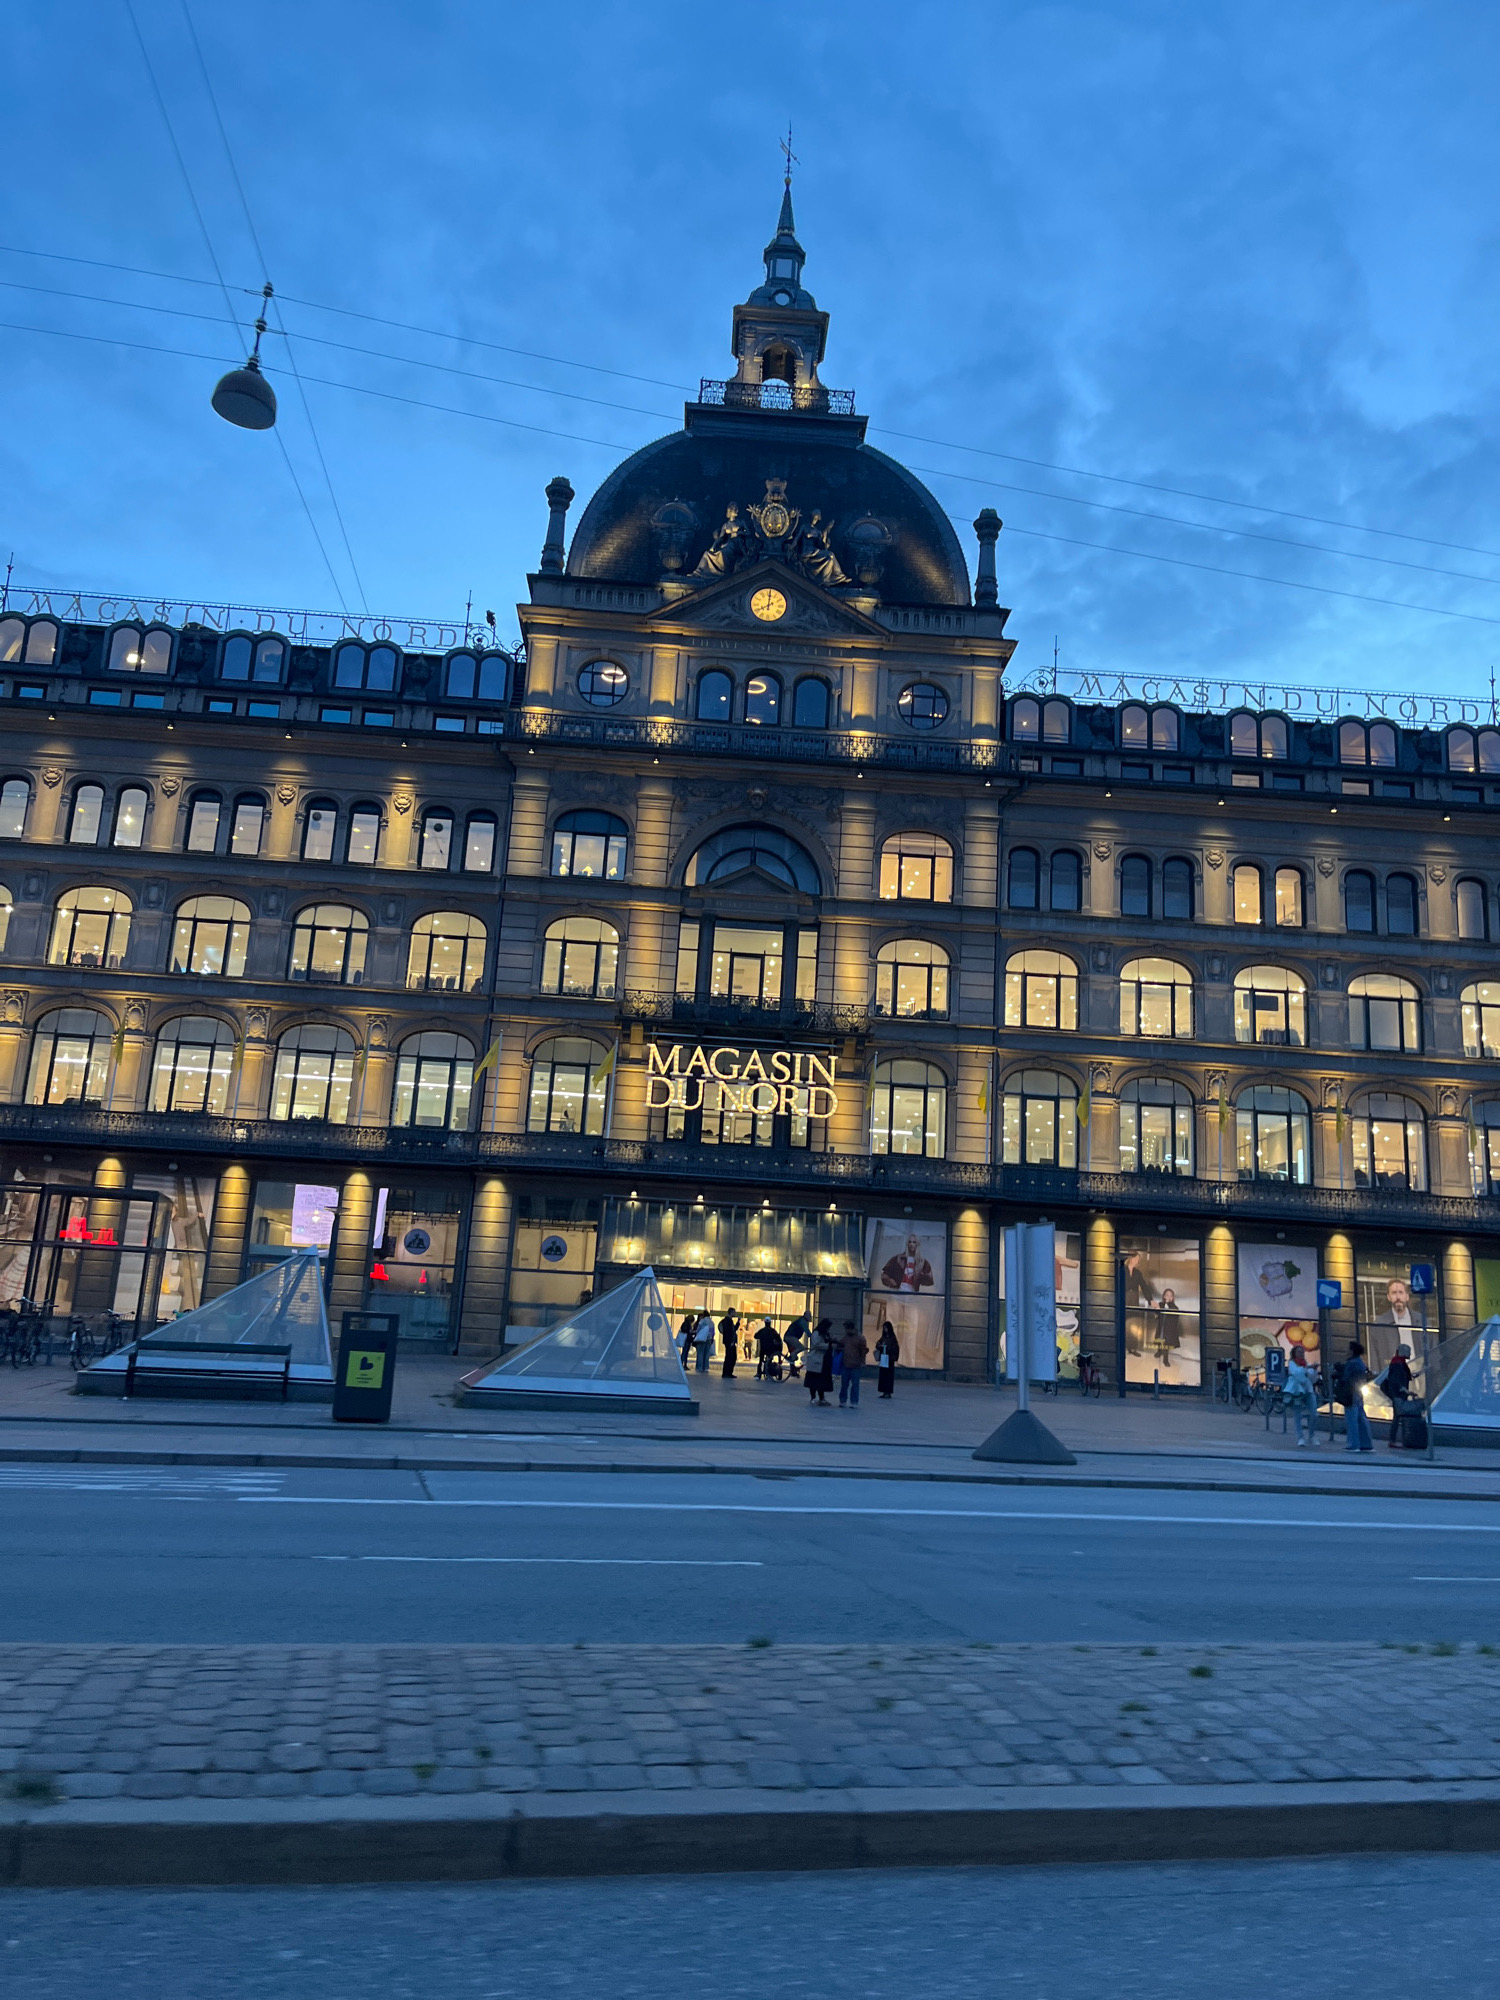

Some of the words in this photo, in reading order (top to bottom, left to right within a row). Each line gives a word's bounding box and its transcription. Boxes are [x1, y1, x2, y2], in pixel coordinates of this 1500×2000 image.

[23, 593, 226, 629] MAGASIN
[253, 611, 306, 637] DU
[338, 618, 457, 648] NORD
[1073, 674, 1265, 708] MAGASIN
[1281, 689, 1334, 715] DU
[1364, 693, 1479, 722] NORD
[645, 1043, 839, 1086] MAGASIN
[645, 1076, 707, 1110] DU
[715, 1080, 839, 1119] NORD
[1271, 1353, 1279, 1370] P
